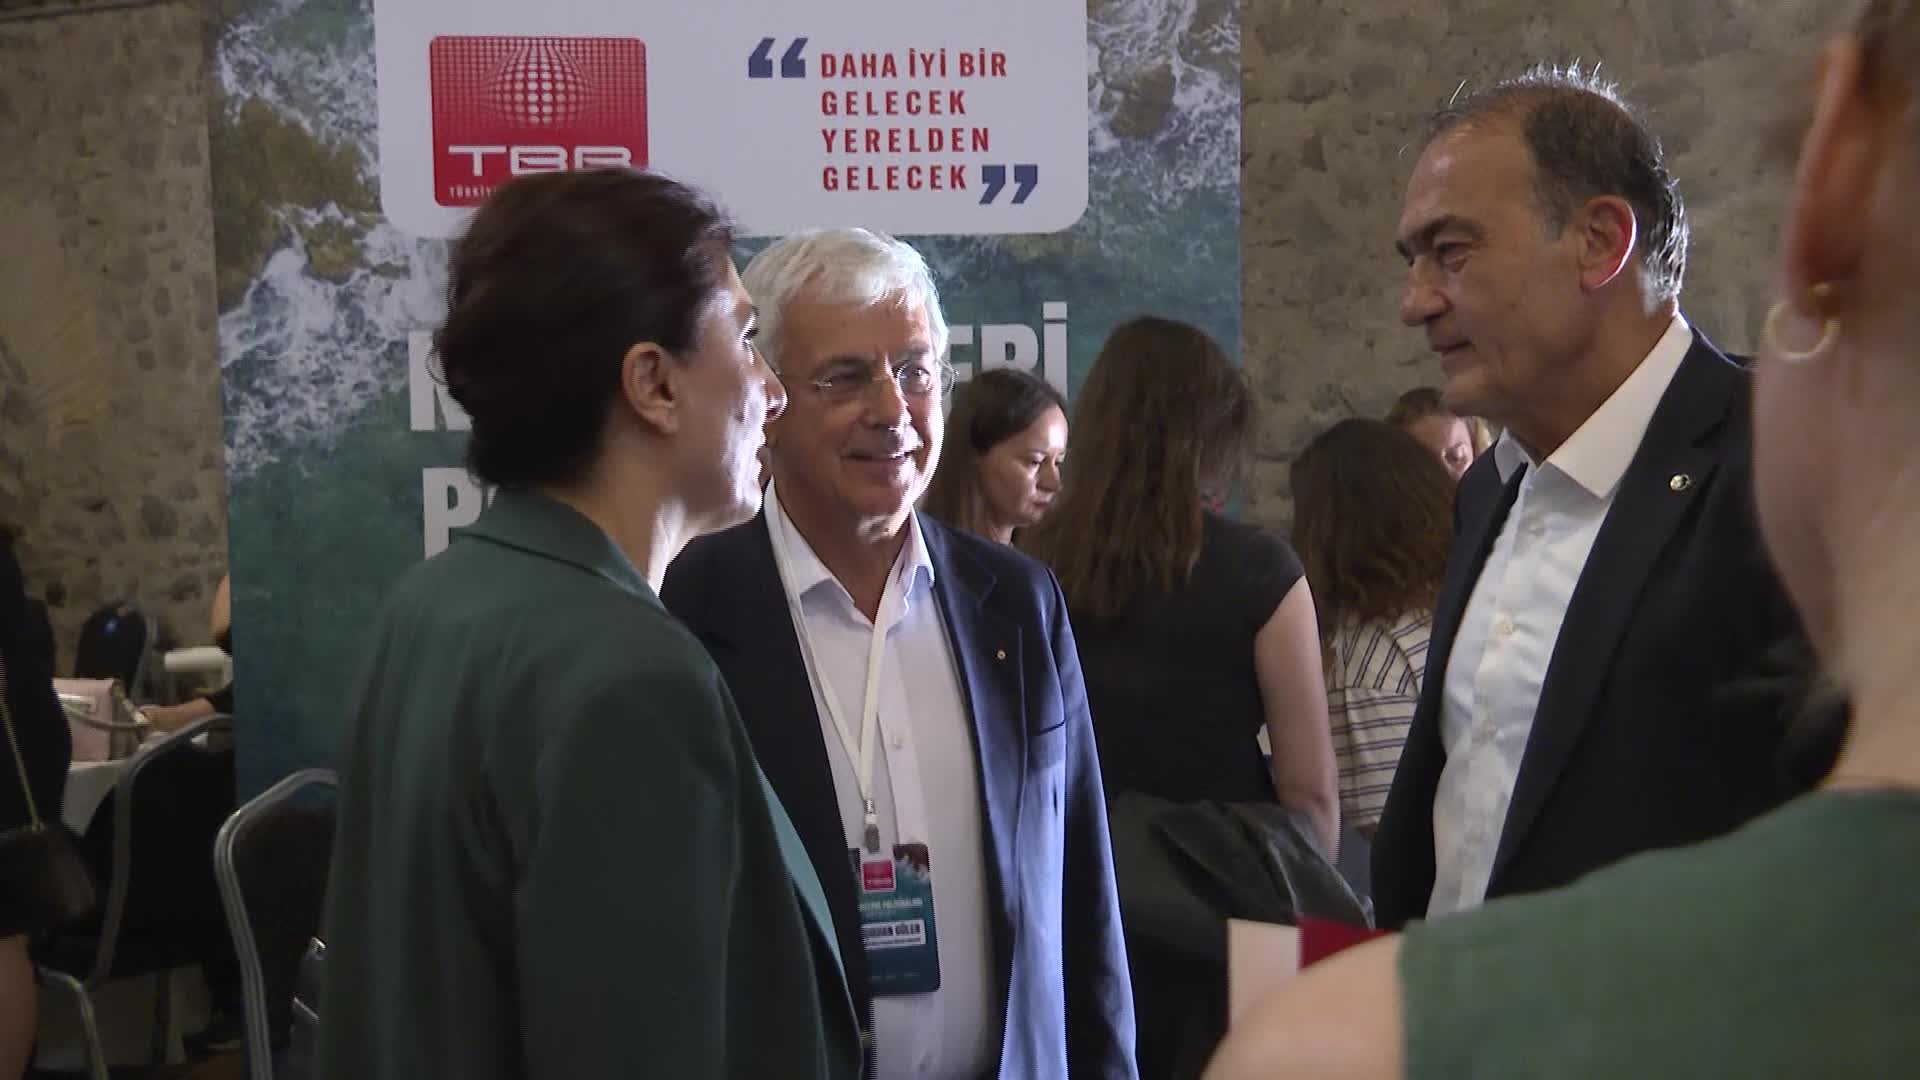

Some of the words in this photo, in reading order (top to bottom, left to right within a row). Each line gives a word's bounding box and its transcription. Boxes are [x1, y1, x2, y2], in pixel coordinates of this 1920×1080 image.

[820, 53, 897, 78] DAHA
[908, 48, 946, 78] İYİ
[959, 48, 1007, 78] BİR
[821, 90, 966, 116] GELECEK
[821, 128, 989, 153] YERELDEN
[822, 165, 967, 191] GELECEK
[449, 184, 497, 199] TÜRKİY
